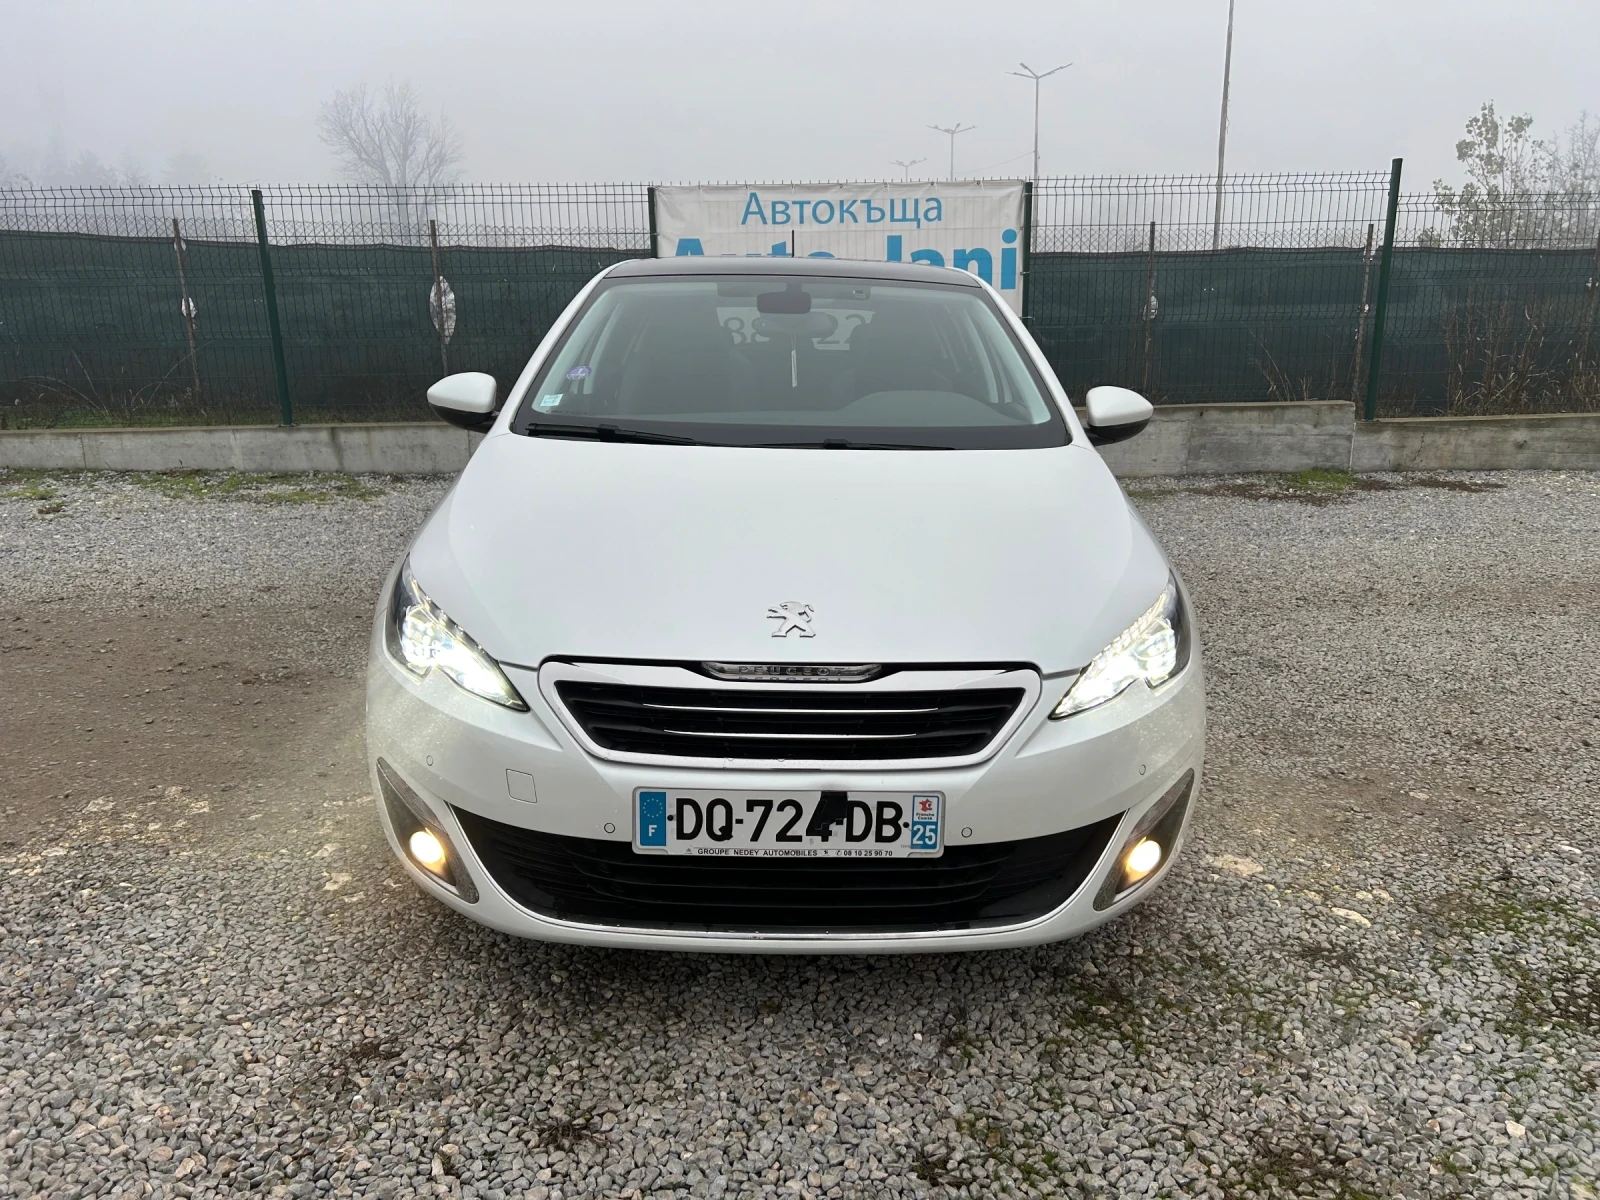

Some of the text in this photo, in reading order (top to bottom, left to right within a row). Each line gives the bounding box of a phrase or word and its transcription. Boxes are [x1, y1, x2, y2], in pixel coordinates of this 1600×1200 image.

[740, 191, 943, 229] Автокъща
[738, 665, 845, 676] PEUGEOT
[647, 824, 657, 837] F
[912, 824, 936, 845] 25
[697, 848, 730, 856] GROUPE
[763, 849, 818, 857] AUTOMOBILES
